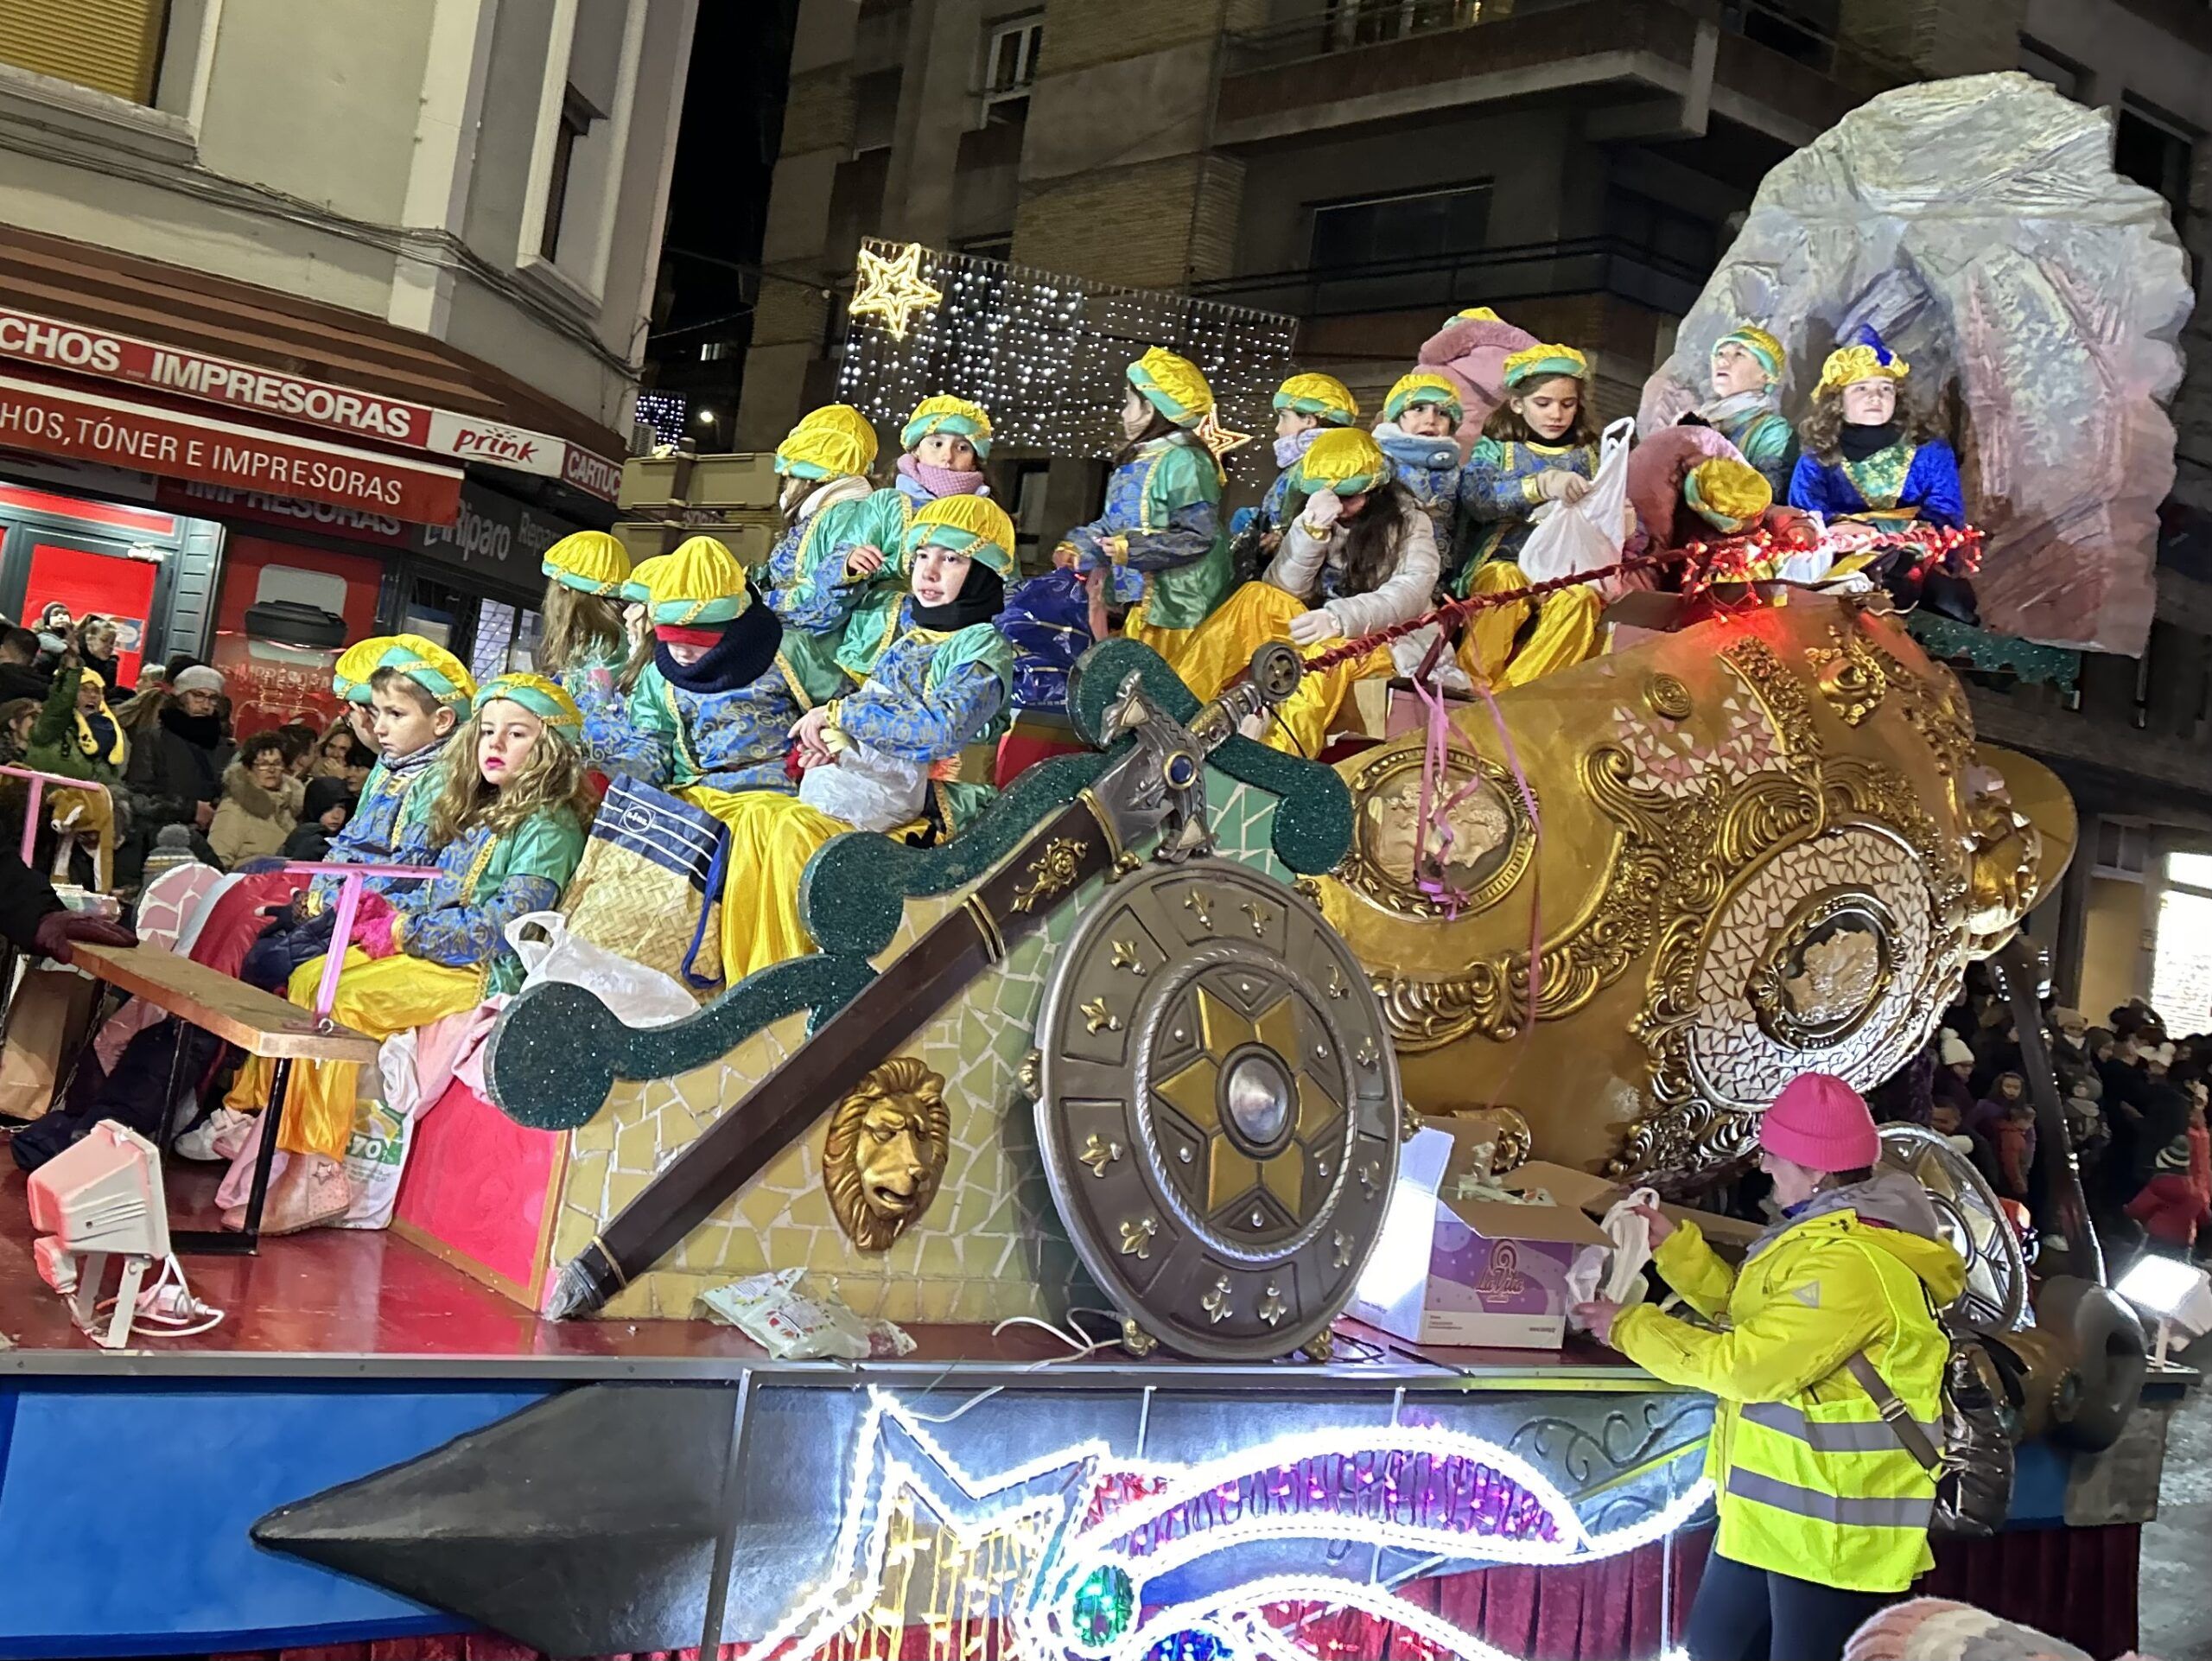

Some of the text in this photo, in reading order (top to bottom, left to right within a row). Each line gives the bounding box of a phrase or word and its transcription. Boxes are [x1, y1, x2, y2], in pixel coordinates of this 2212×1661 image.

[0, 317, 411, 439] CHOS IMPRESORAS
[186, 440, 205, 467] E
[213, 444, 403, 505] IMPRESORAS
[453, 428, 539, 463] prink
